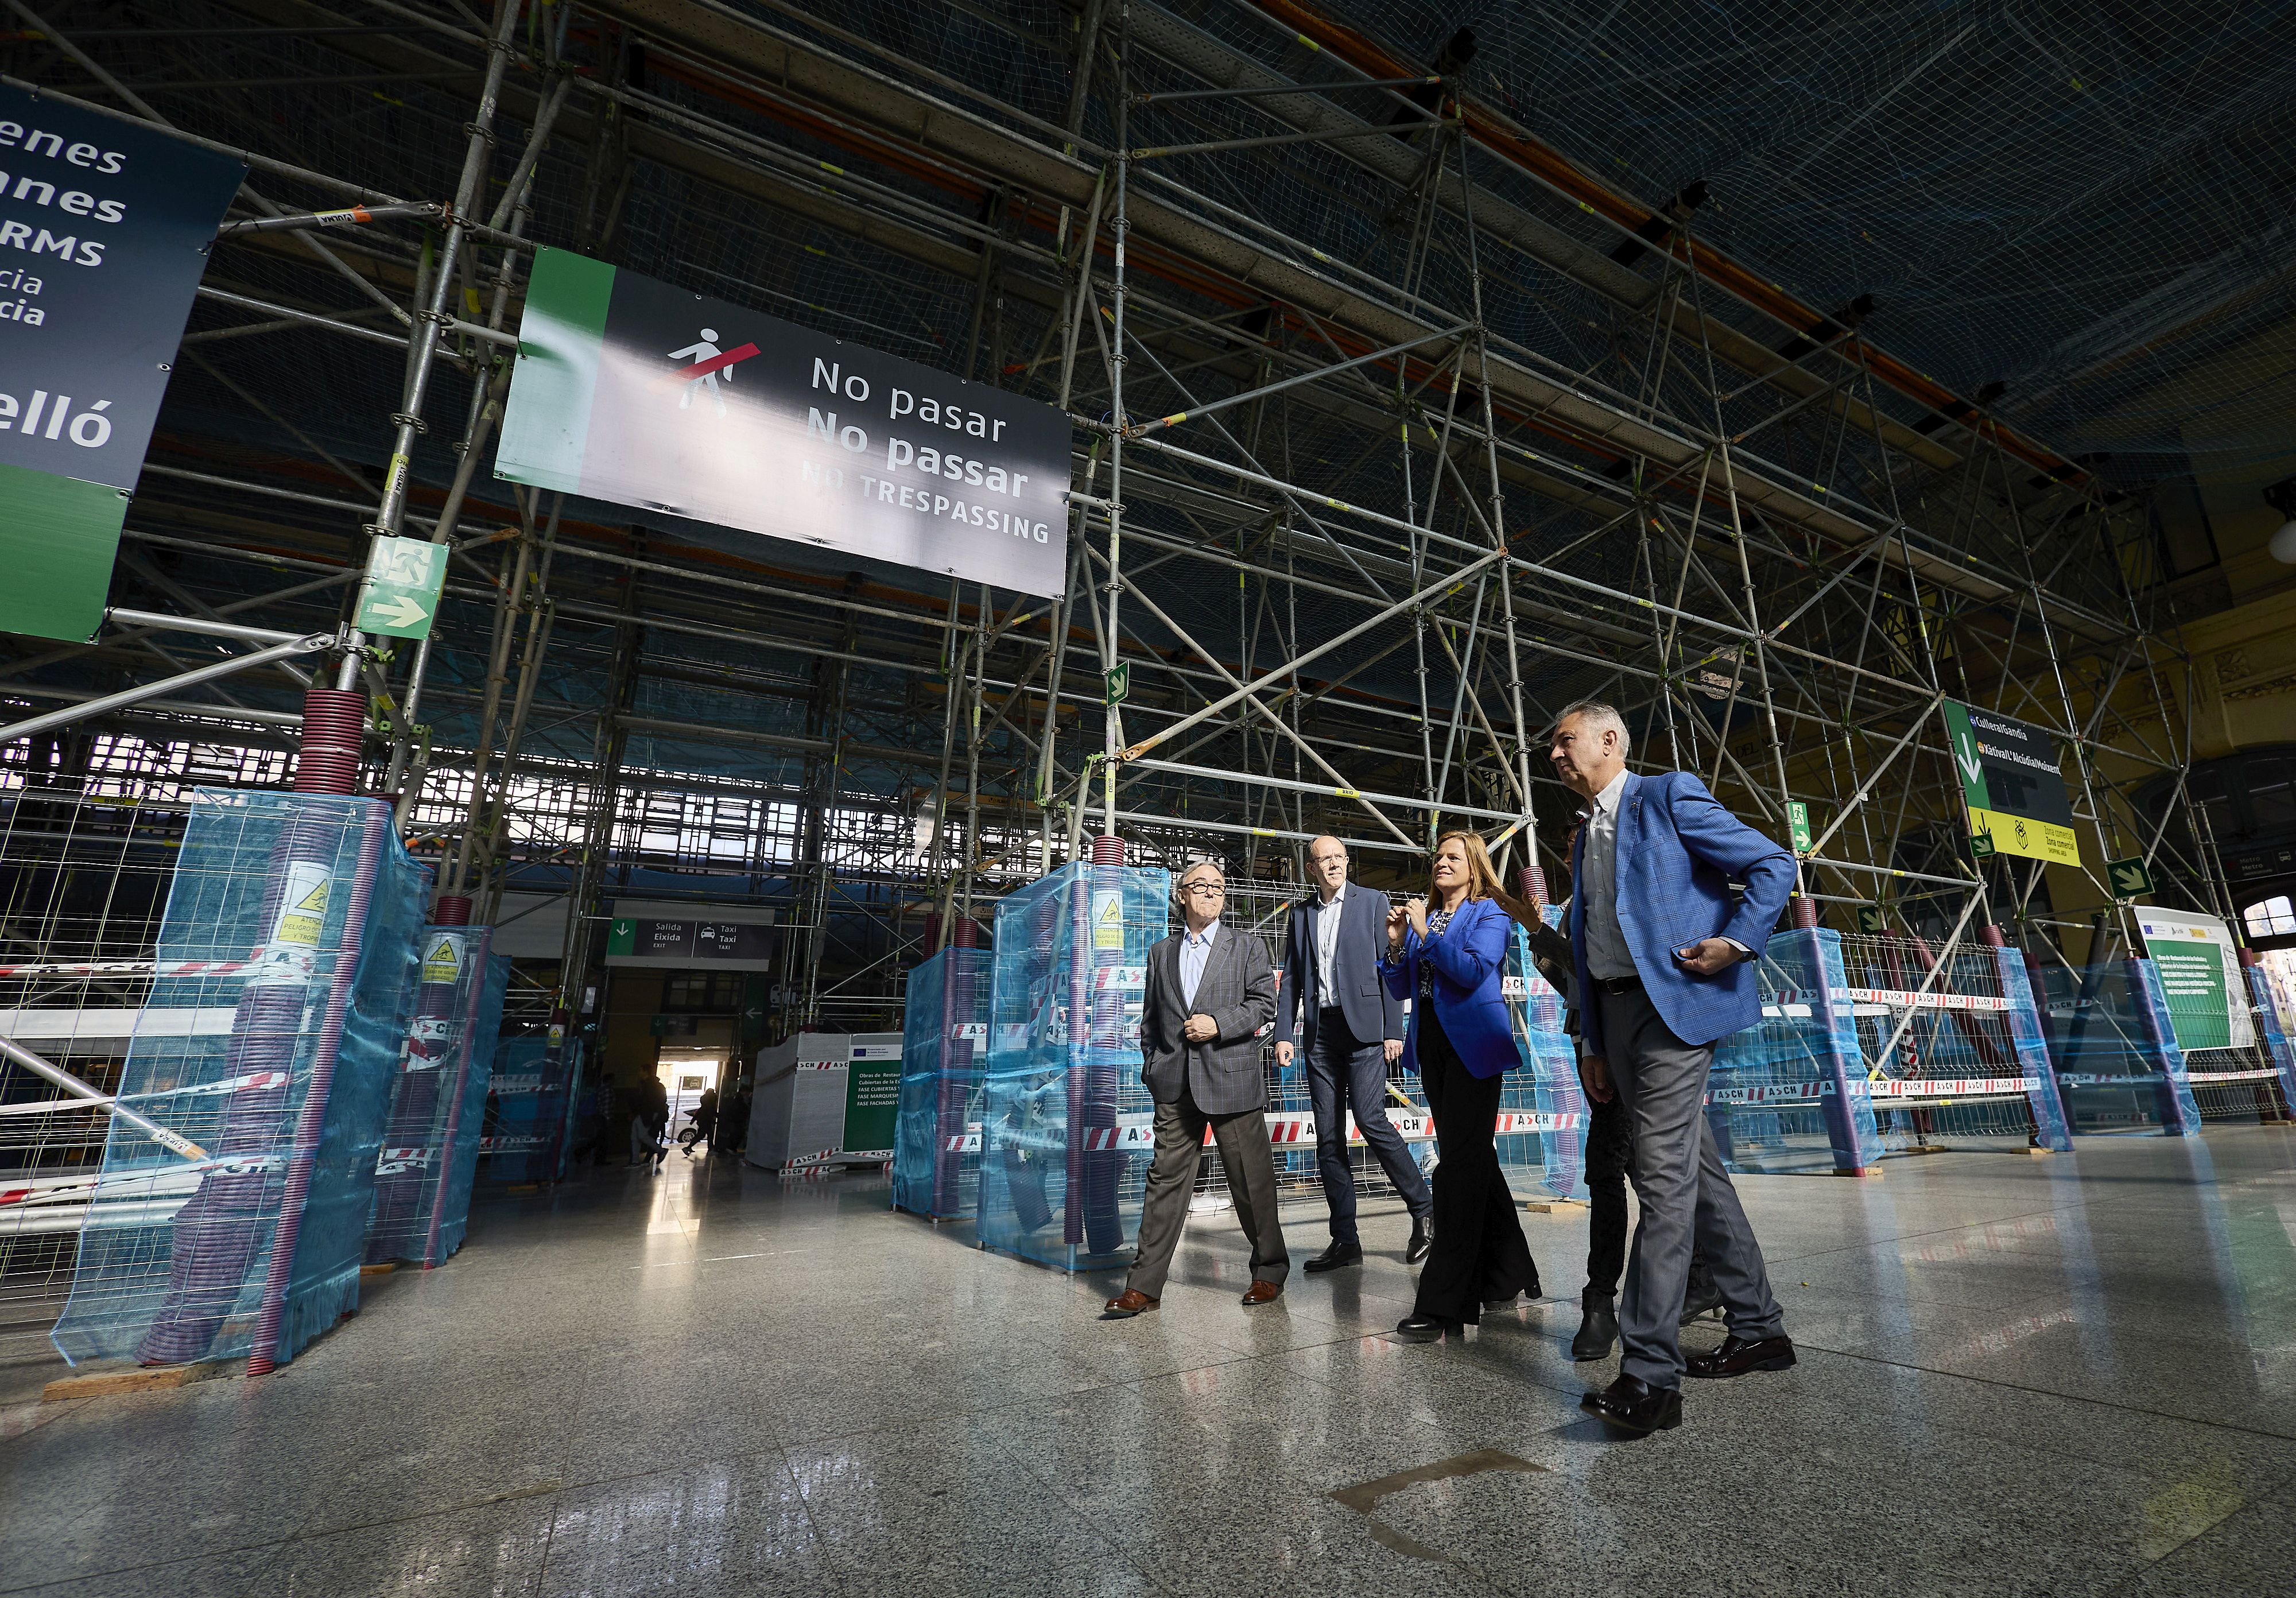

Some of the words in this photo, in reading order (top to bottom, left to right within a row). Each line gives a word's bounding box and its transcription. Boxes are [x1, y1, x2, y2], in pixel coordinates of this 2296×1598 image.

[321, 214, 344, 223] ULMA
[812, 357, 870, 402] No
[890, 388, 1006, 442] pasar
[807, 406, 868, 453] No
[887, 437, 1028, 498] passar
[861, 475, 1049, 544] TRESPASSING
[2044, 825, 2054, 836] Zona
[2055, 830, 2073, 840] comercial
[2046, 836, 2056, 846] Zona
[2057, 841, 2074, 850] comercial
[284, 924, 311, 932] PELIGRO
[656, 922, 681, 931] Salida
[654, 933, 681, 941] Eixida
[719, 935, 736, 943] Taxi
[1849, 990, 1867, 998] ASCH
[1885, 992, 1902, 1000] ASCH
[2049, 1002, 2072, 1010] ASCH
[1719, 1089, 1743, 1099] ASCH
[1769, 1085, 1797, 1096] ASCH
[1870, 1083, 1887, 1091] ASCH
[1518, 1114, 1549, 1126] ASCH
[796, 1154, 817, 1164] ASCH
